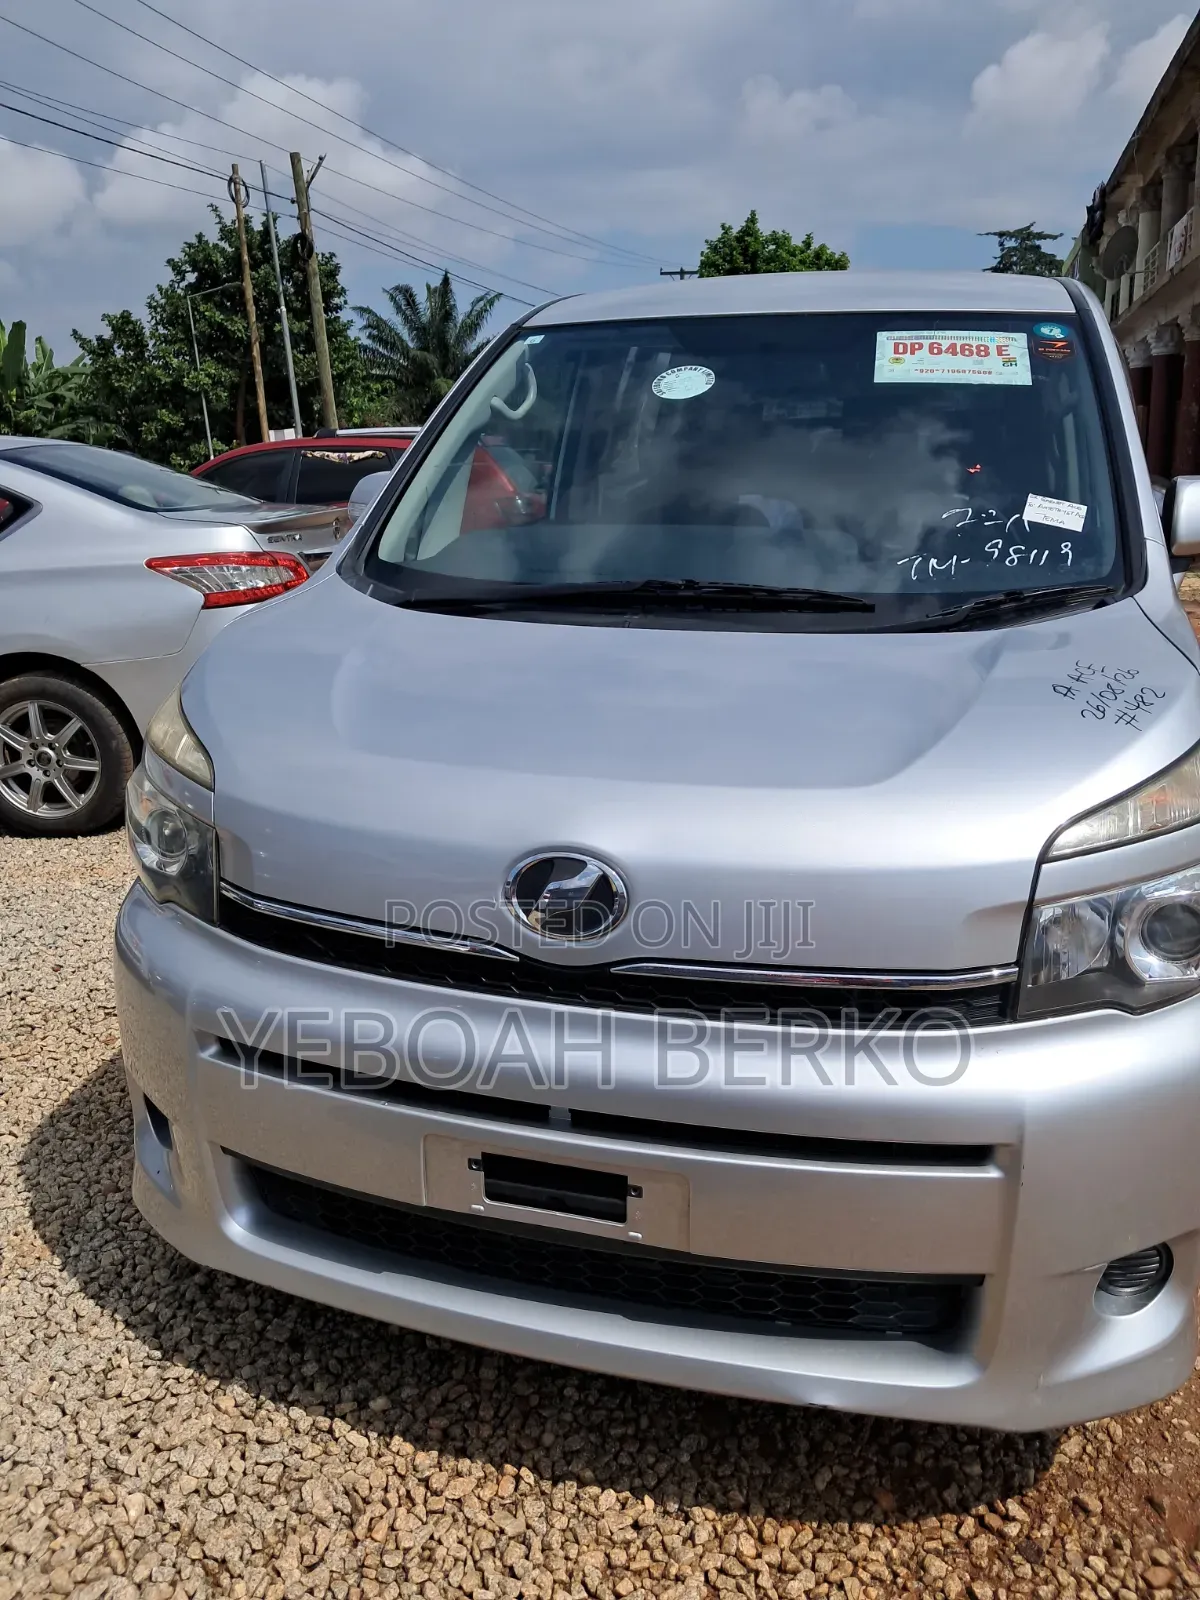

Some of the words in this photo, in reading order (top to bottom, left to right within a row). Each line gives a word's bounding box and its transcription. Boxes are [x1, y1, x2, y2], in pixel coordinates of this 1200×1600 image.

[893, 341, 924, 356] DP
[928, 341, 991, 358] 6468
[995, 344, 1011, 357] E
[666, 366, 703, 376] COMPANY
[266, 532, 303, 544] SENTRA
[1114, 686, 1166, 732] #482
